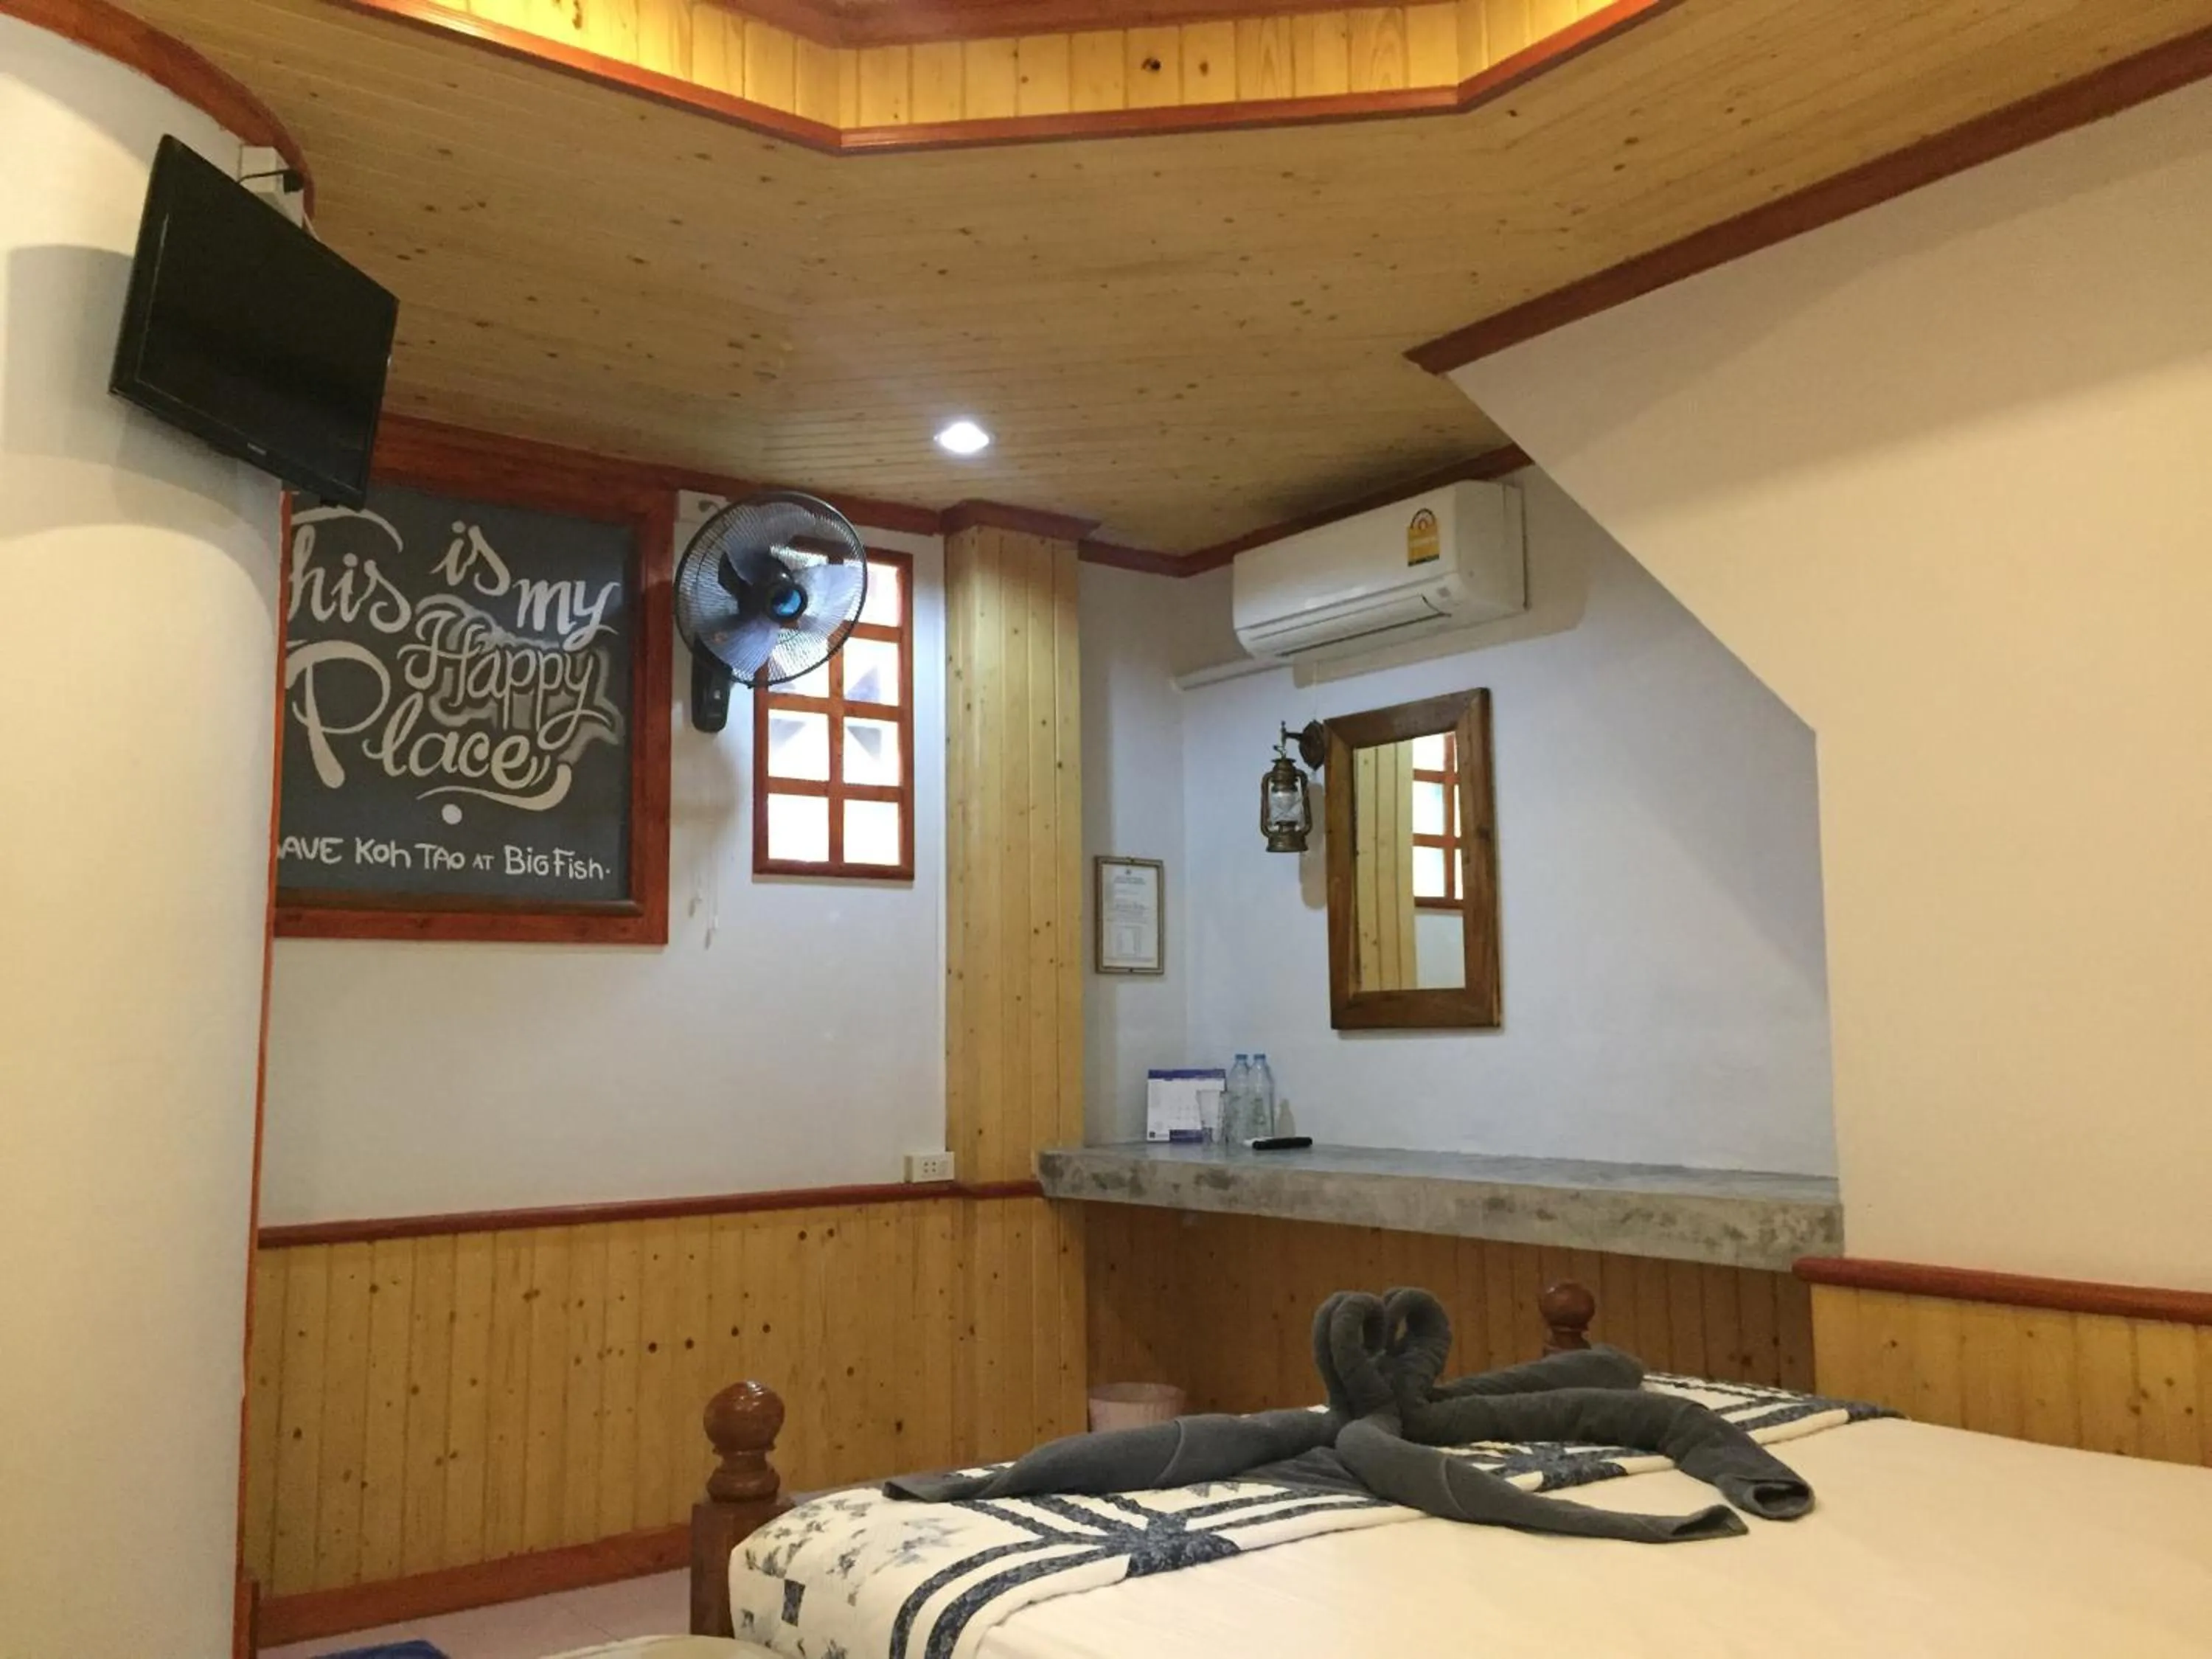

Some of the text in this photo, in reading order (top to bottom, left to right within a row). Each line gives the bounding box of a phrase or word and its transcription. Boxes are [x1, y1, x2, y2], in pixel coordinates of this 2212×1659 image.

[429, 520, 511, 597] is
[512, 578, 621, 652] my
[285, 639, 551, 789] Place
[397, 610, 613, 750] Happy
[277, 835, 344, 865] AVE
[355, 836, 412, 869] Koh
[472, 853, 495, 871] AT
